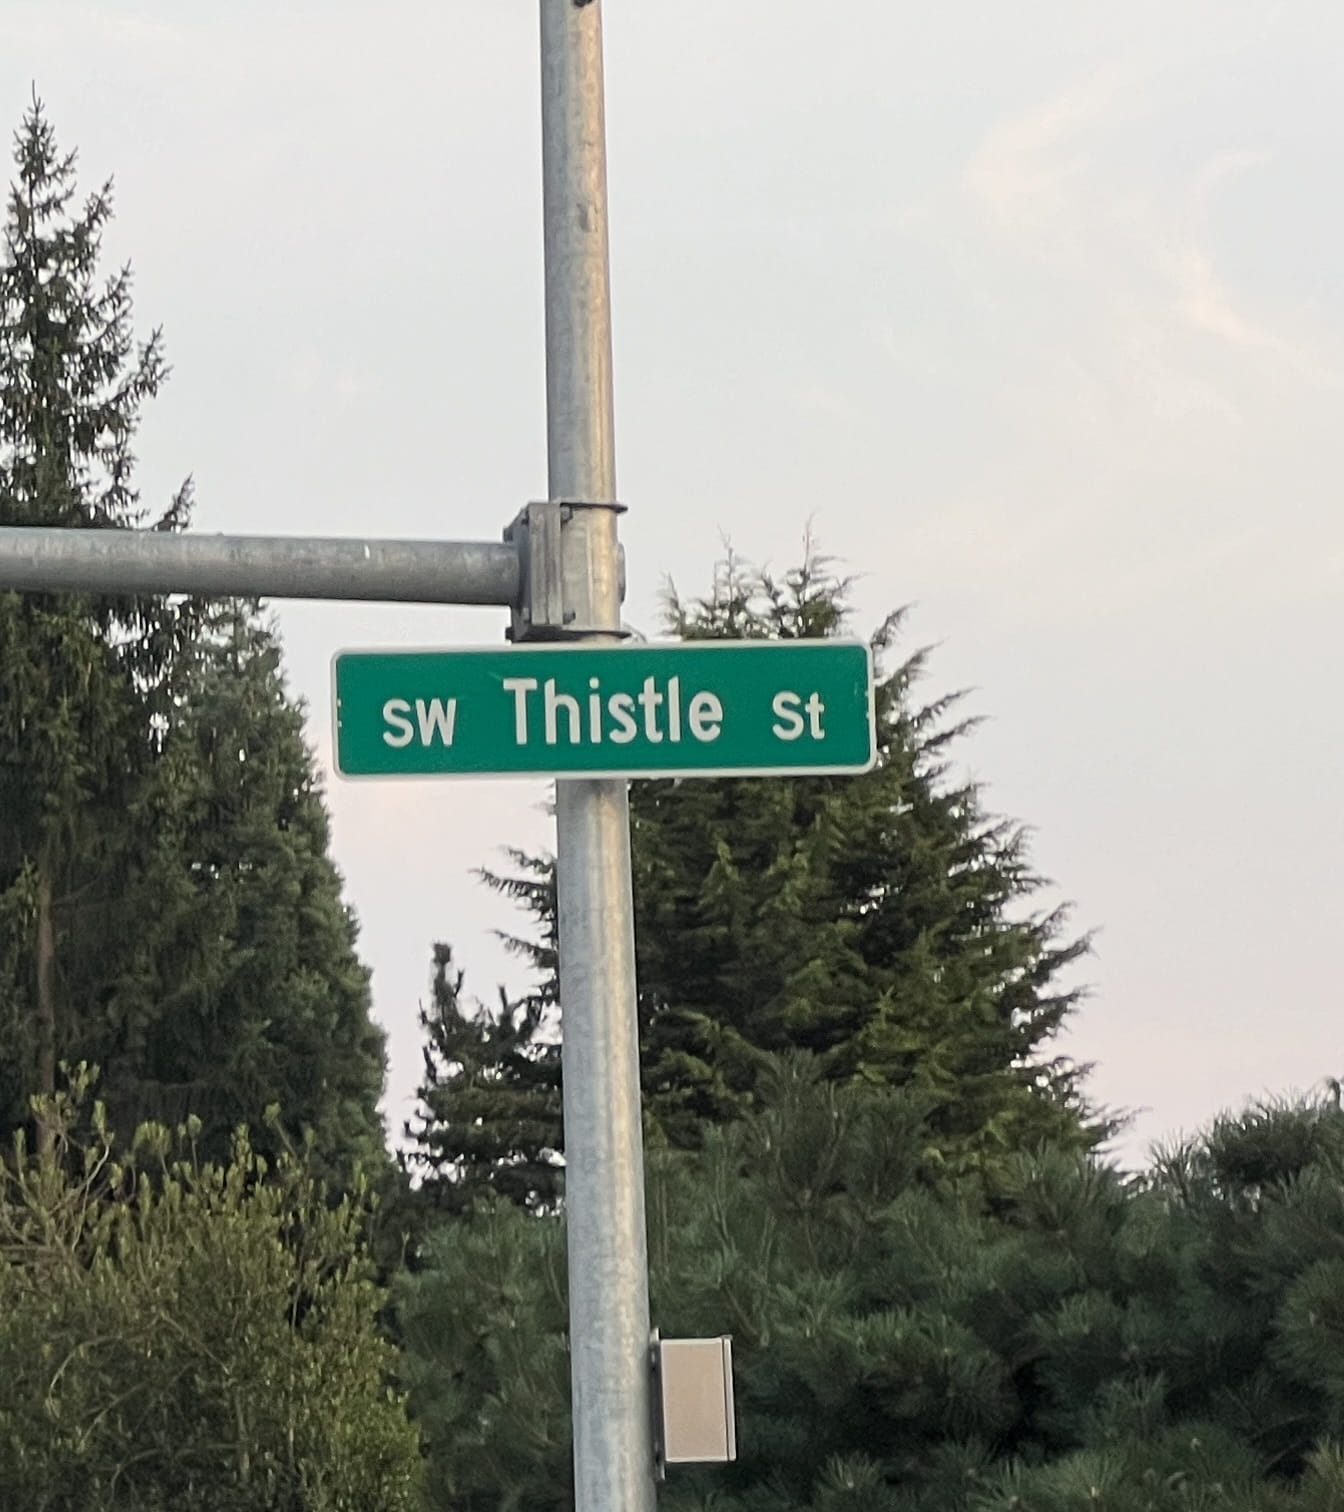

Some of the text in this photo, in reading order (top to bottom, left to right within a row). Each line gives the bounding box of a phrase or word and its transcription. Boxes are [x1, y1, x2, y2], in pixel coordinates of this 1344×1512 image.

[381, 675, 826, 748] SW Thistle St
